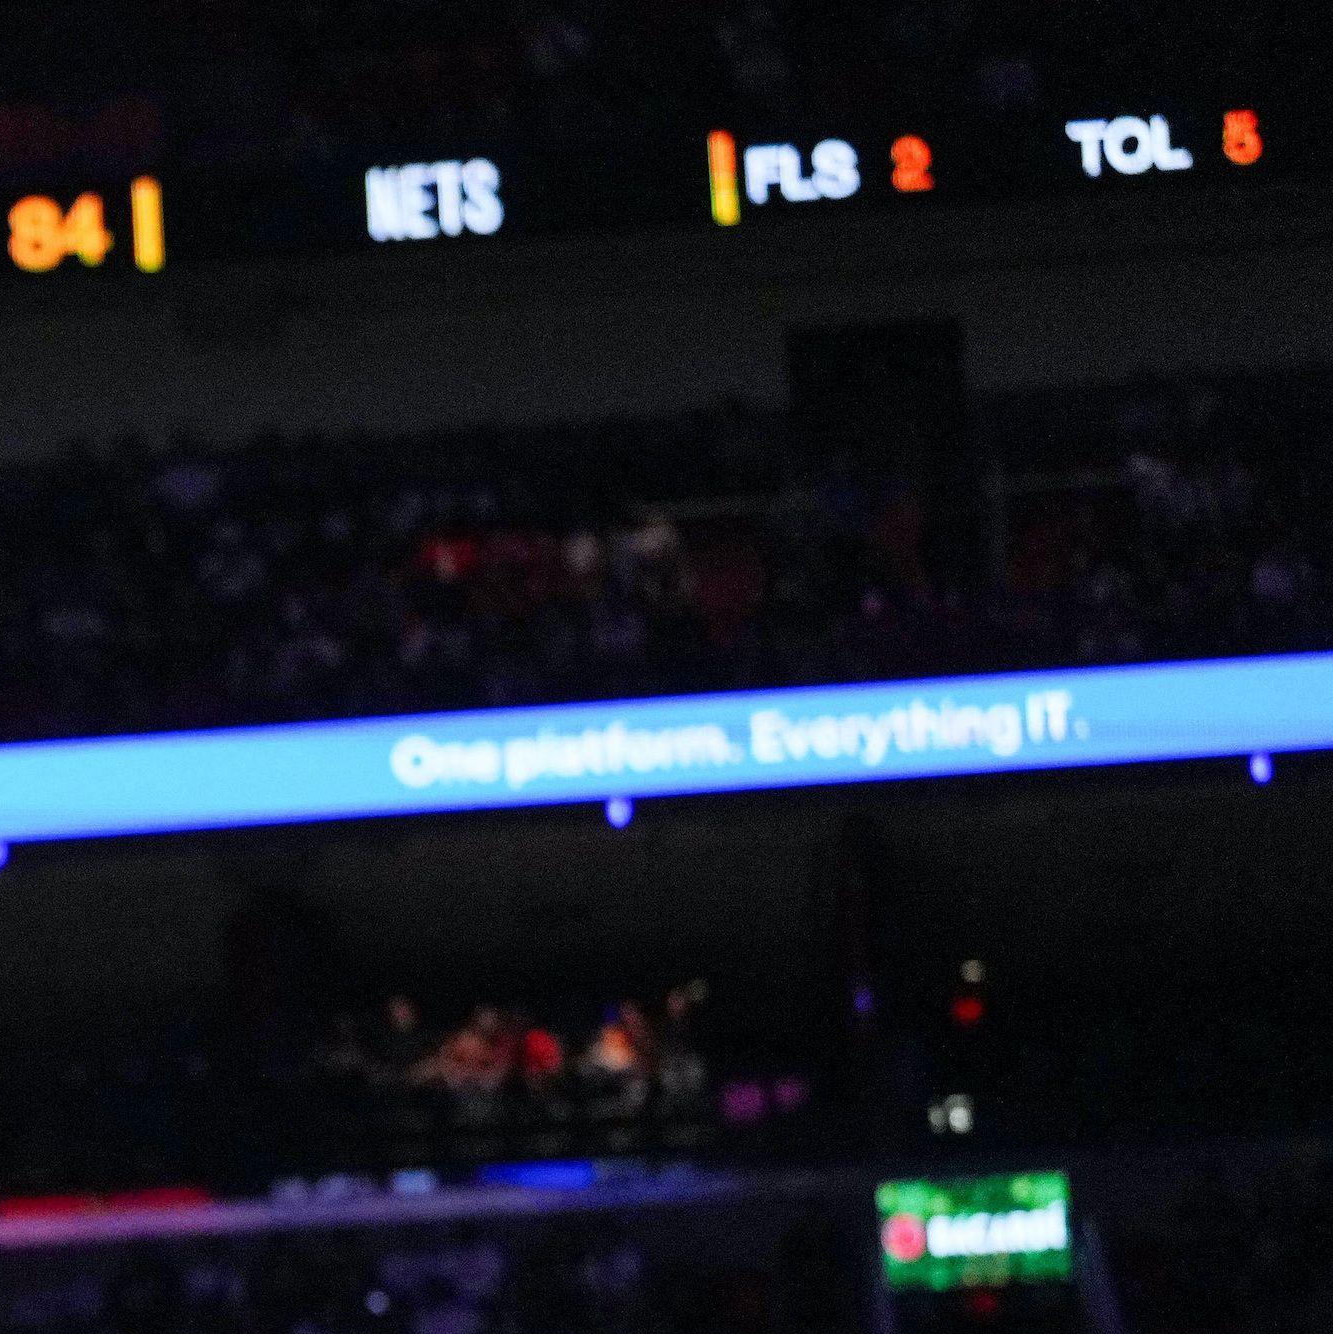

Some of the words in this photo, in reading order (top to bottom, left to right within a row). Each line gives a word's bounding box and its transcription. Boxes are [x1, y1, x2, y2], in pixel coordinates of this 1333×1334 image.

[743, 138, 861, 204] FLS
[1065, 113, 1193, 177] TOL
[365, 157, 504, 240] NETS
